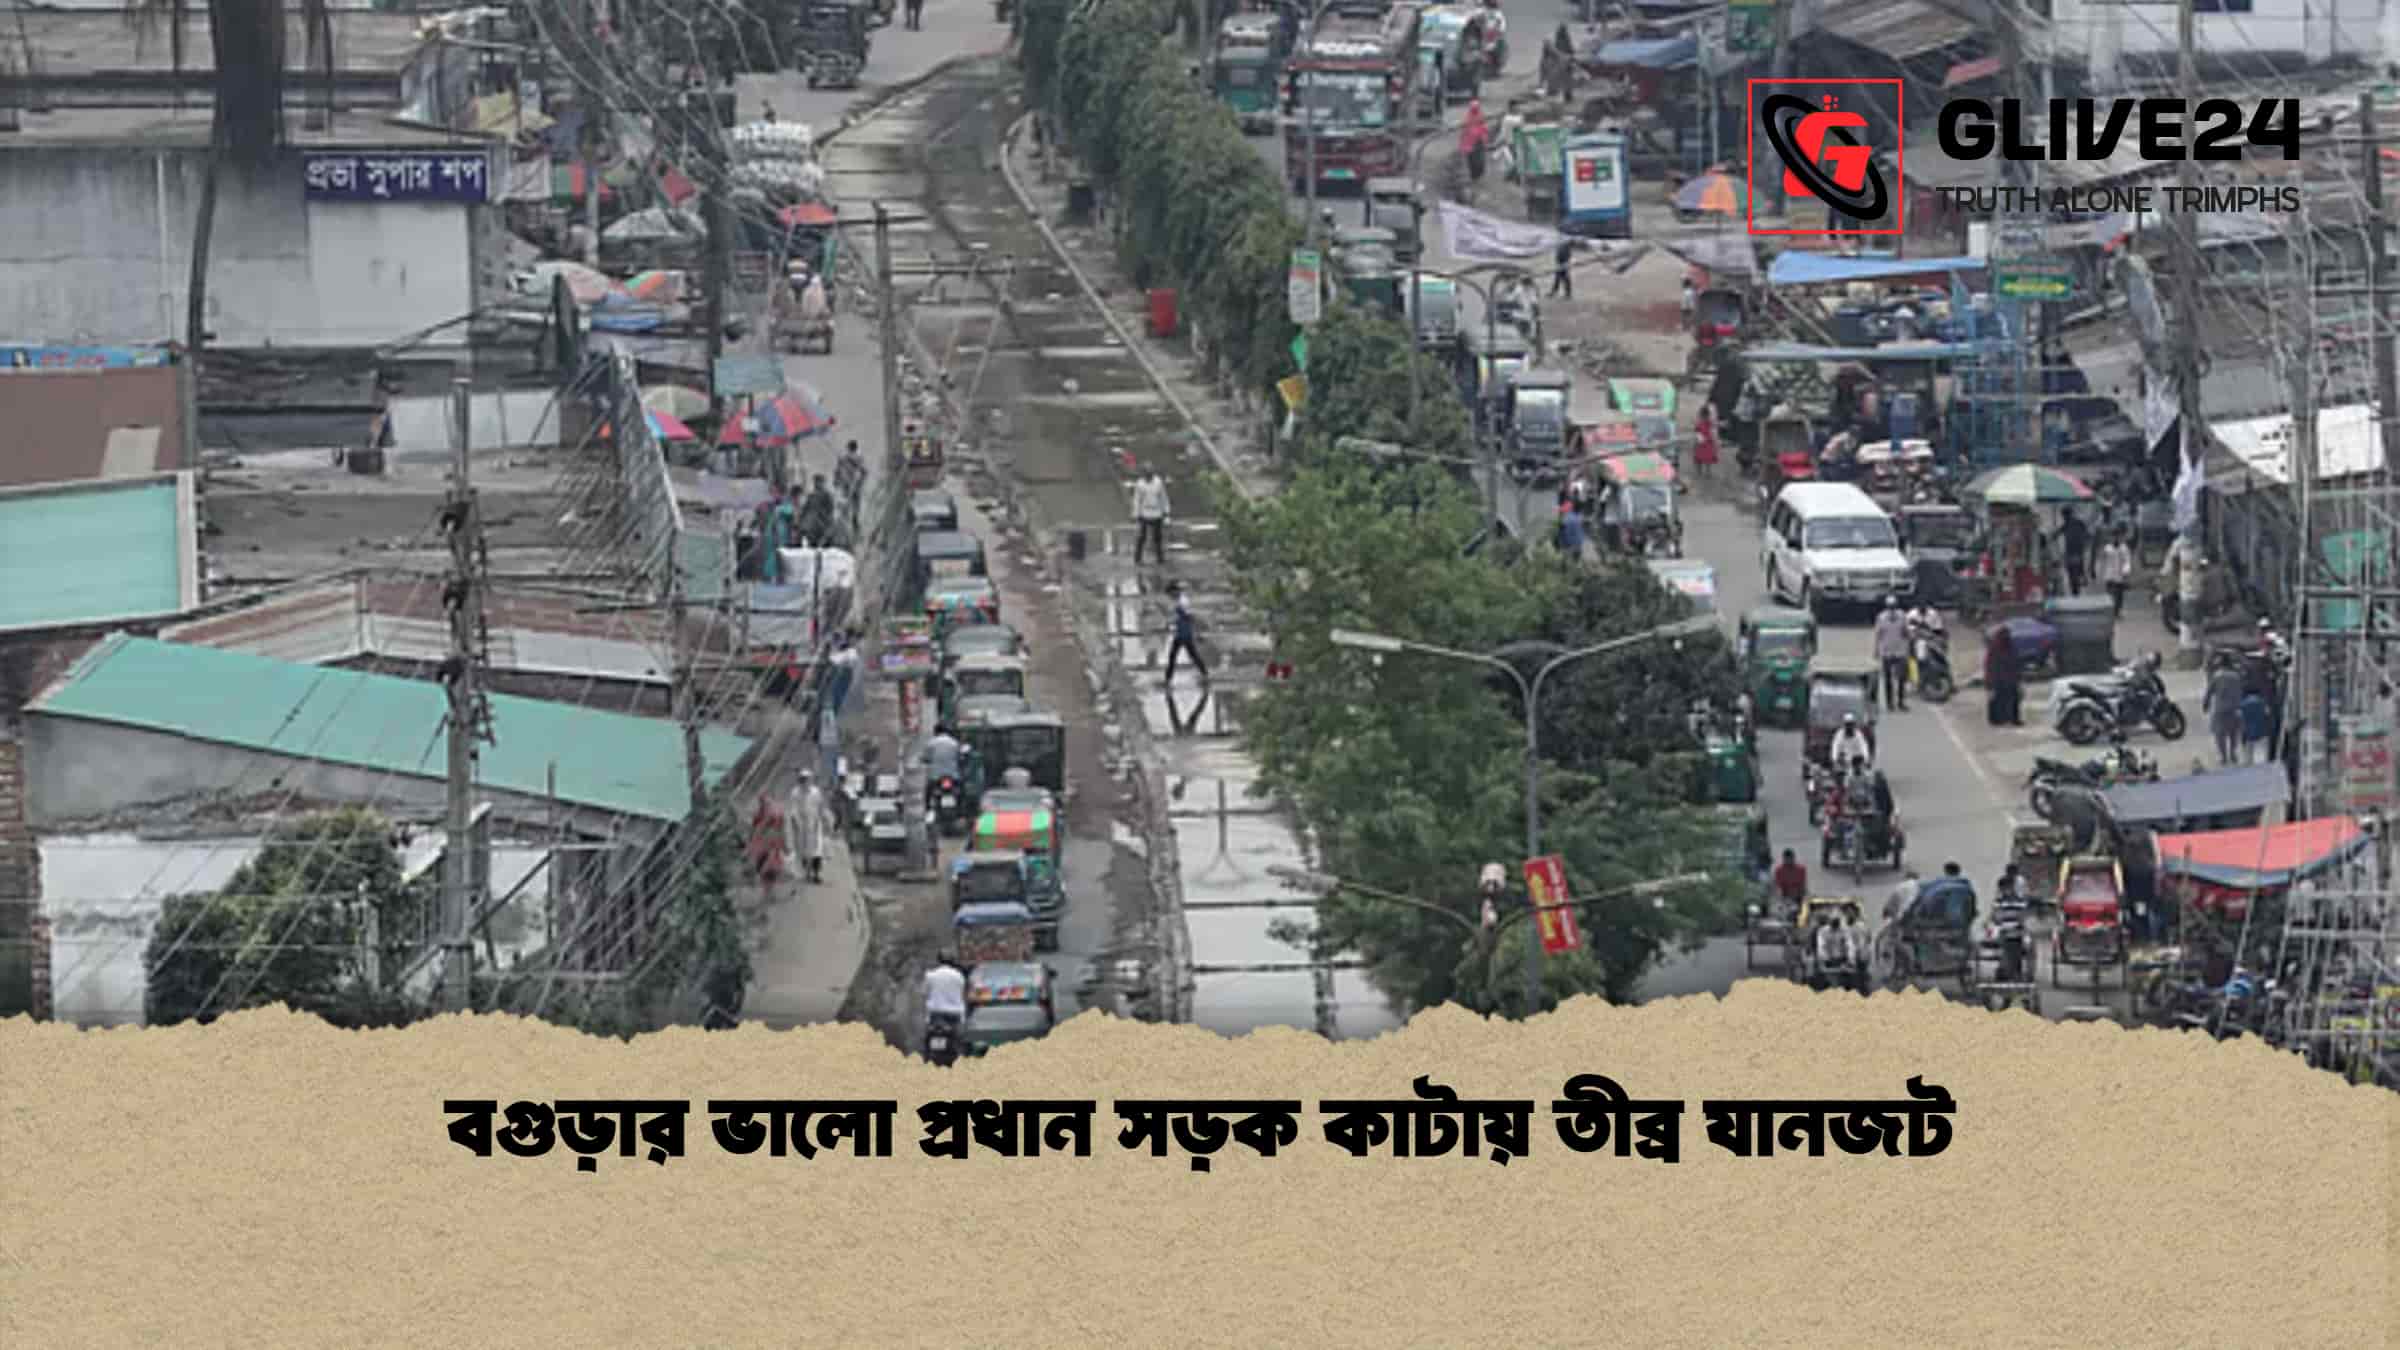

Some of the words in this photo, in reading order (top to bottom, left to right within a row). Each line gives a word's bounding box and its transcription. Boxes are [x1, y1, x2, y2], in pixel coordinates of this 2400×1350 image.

[307, 157, 359, 191] প্রভা
[364, 157, 433, 197] সুপার
[437, 157, 485, 190] শপ
